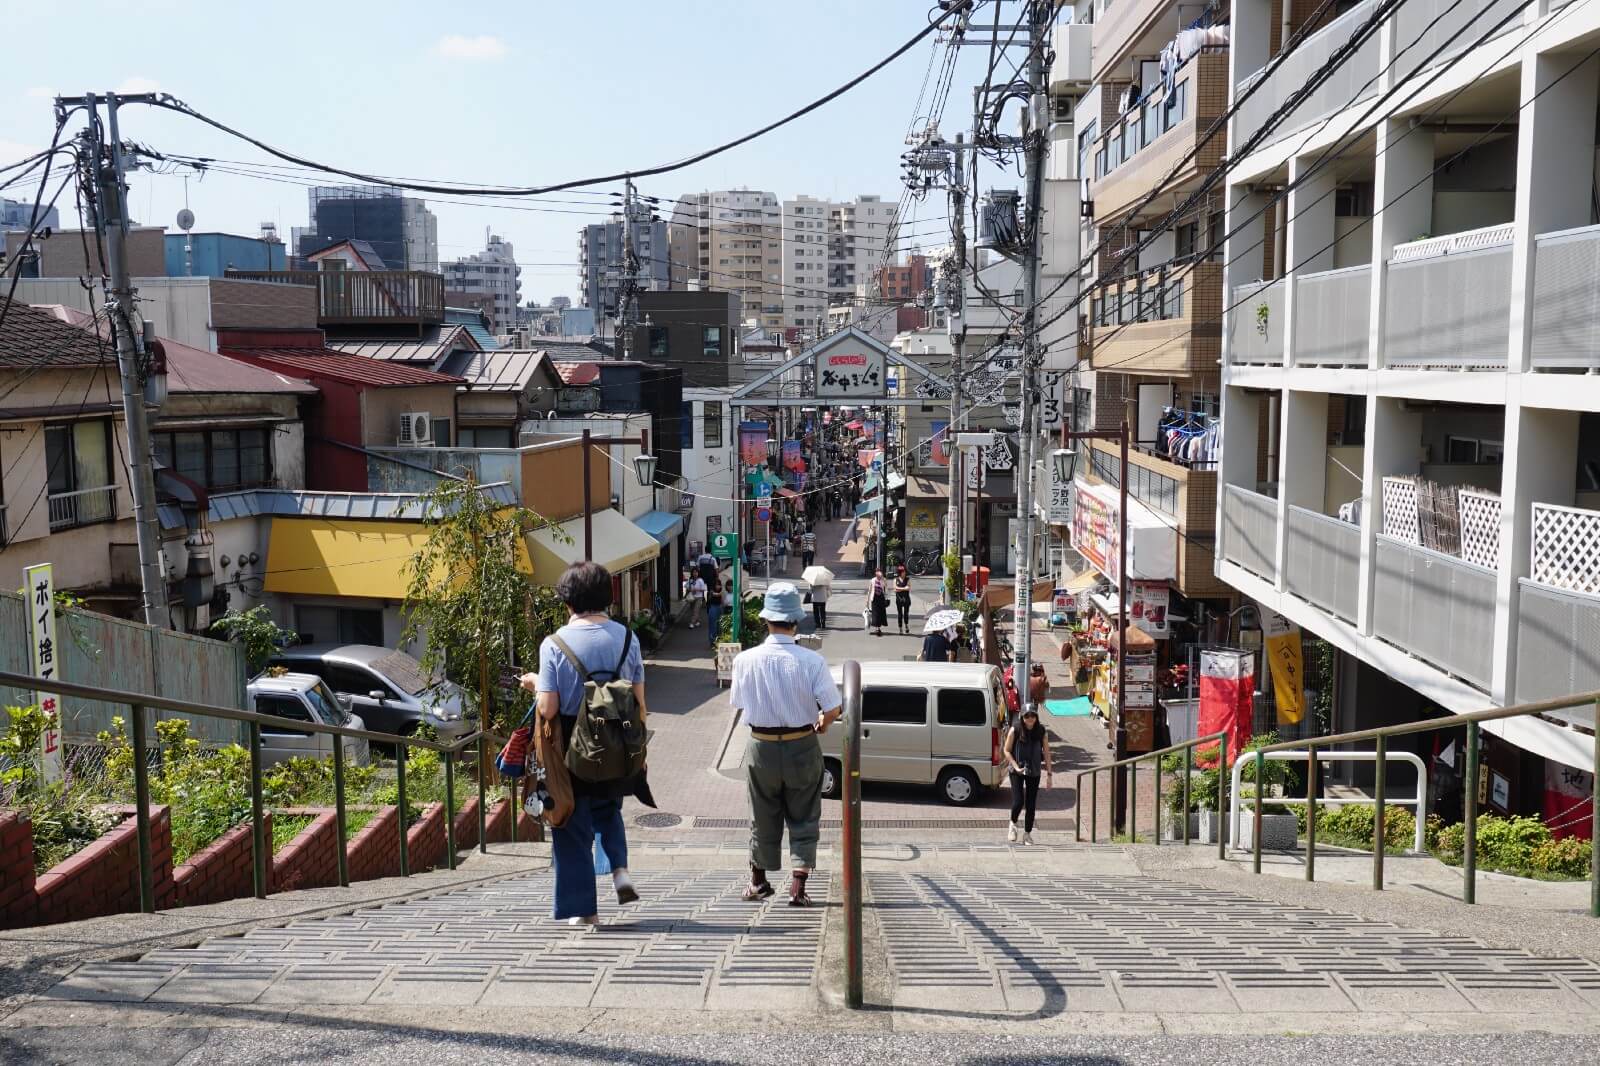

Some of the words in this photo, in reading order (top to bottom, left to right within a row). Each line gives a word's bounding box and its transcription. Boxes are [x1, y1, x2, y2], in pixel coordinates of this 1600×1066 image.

[821, 362, 880, 391] 谷中ぎんざ
[1056, 598, 1075, 607] 焼肉
